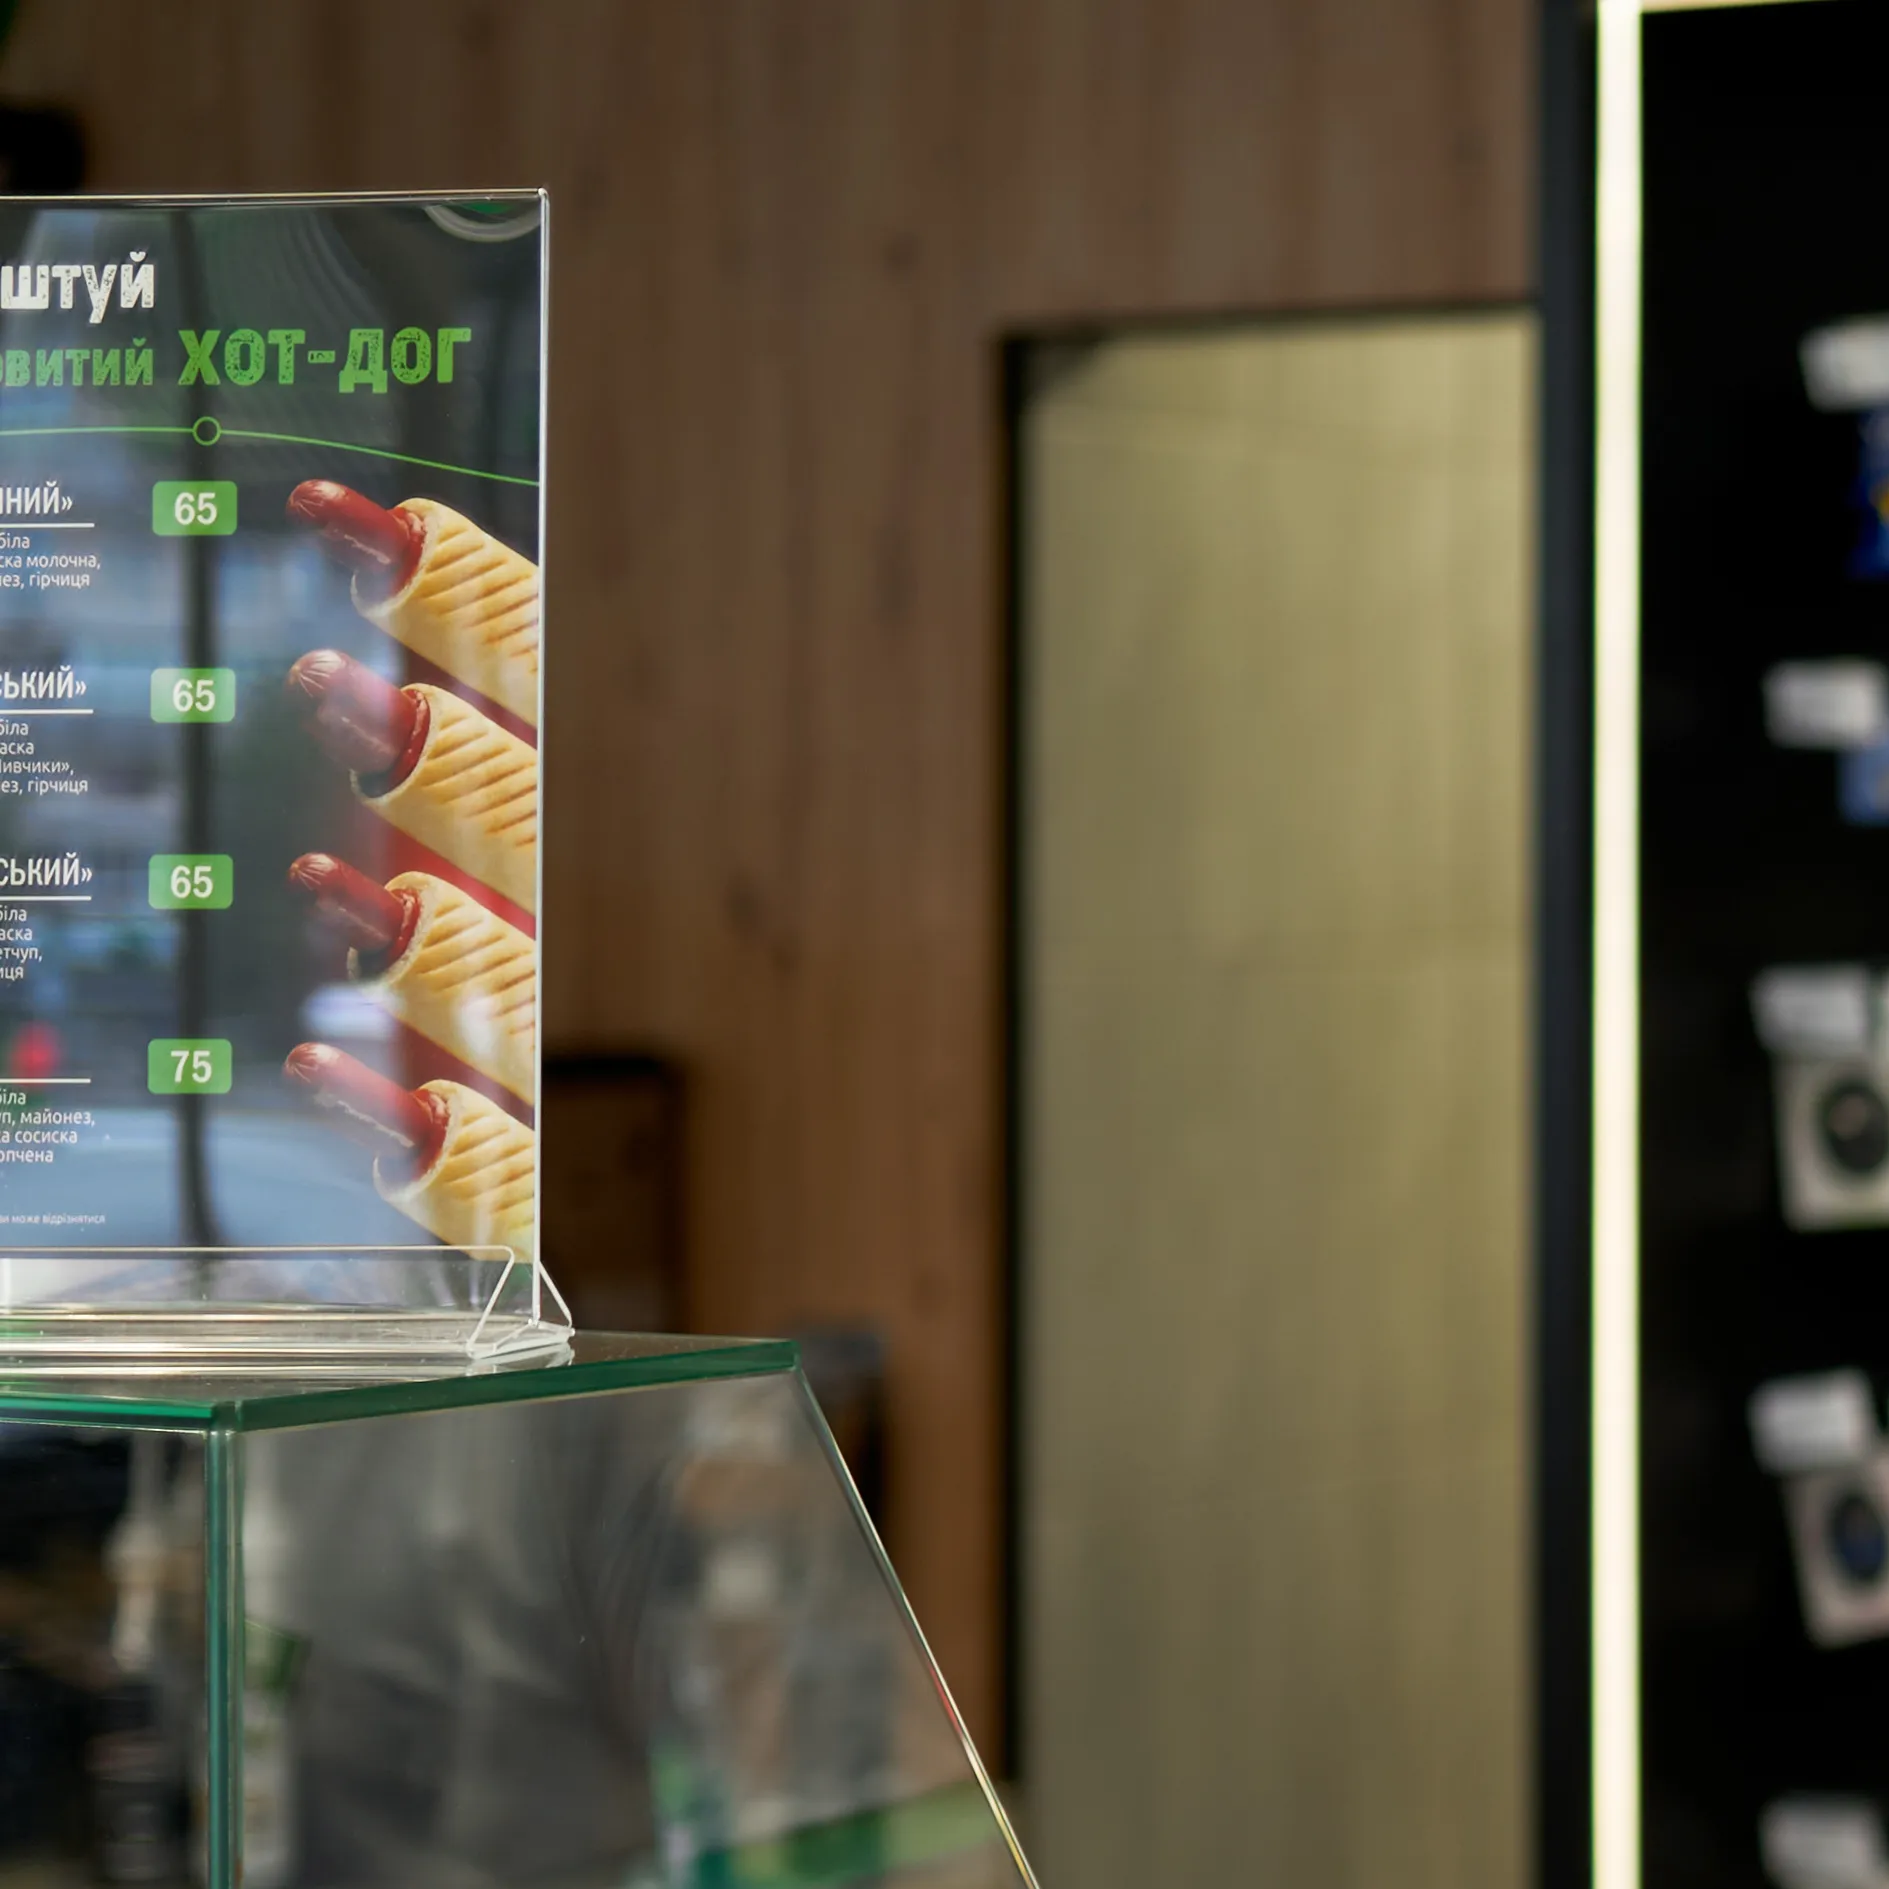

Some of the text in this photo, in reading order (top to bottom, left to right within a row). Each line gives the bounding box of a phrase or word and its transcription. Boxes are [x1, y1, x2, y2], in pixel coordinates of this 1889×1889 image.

[0, 327, 472, 393] витий ХОТ-ДОГ
[0, 480, 73, 514] НИЙ»
[174, 493, 217, 525] 65
[26, 555, 101, 570] молочна,
[0, 571, 91, 590] ез, гірчиця
[0, 665, 87, 699] ЬКИЙ»
[172, 680, 215, 712] 65
[0, 759, 74, 776] ивчики»,
[27, 776, 88, 796] гірчиця
[170, 865, 213, 898] 65
[170, 1050, 213, 1083] 75
[20, 1108, 96, 1127] майонез,
[15, 1130, 78, 1144] сосиска
